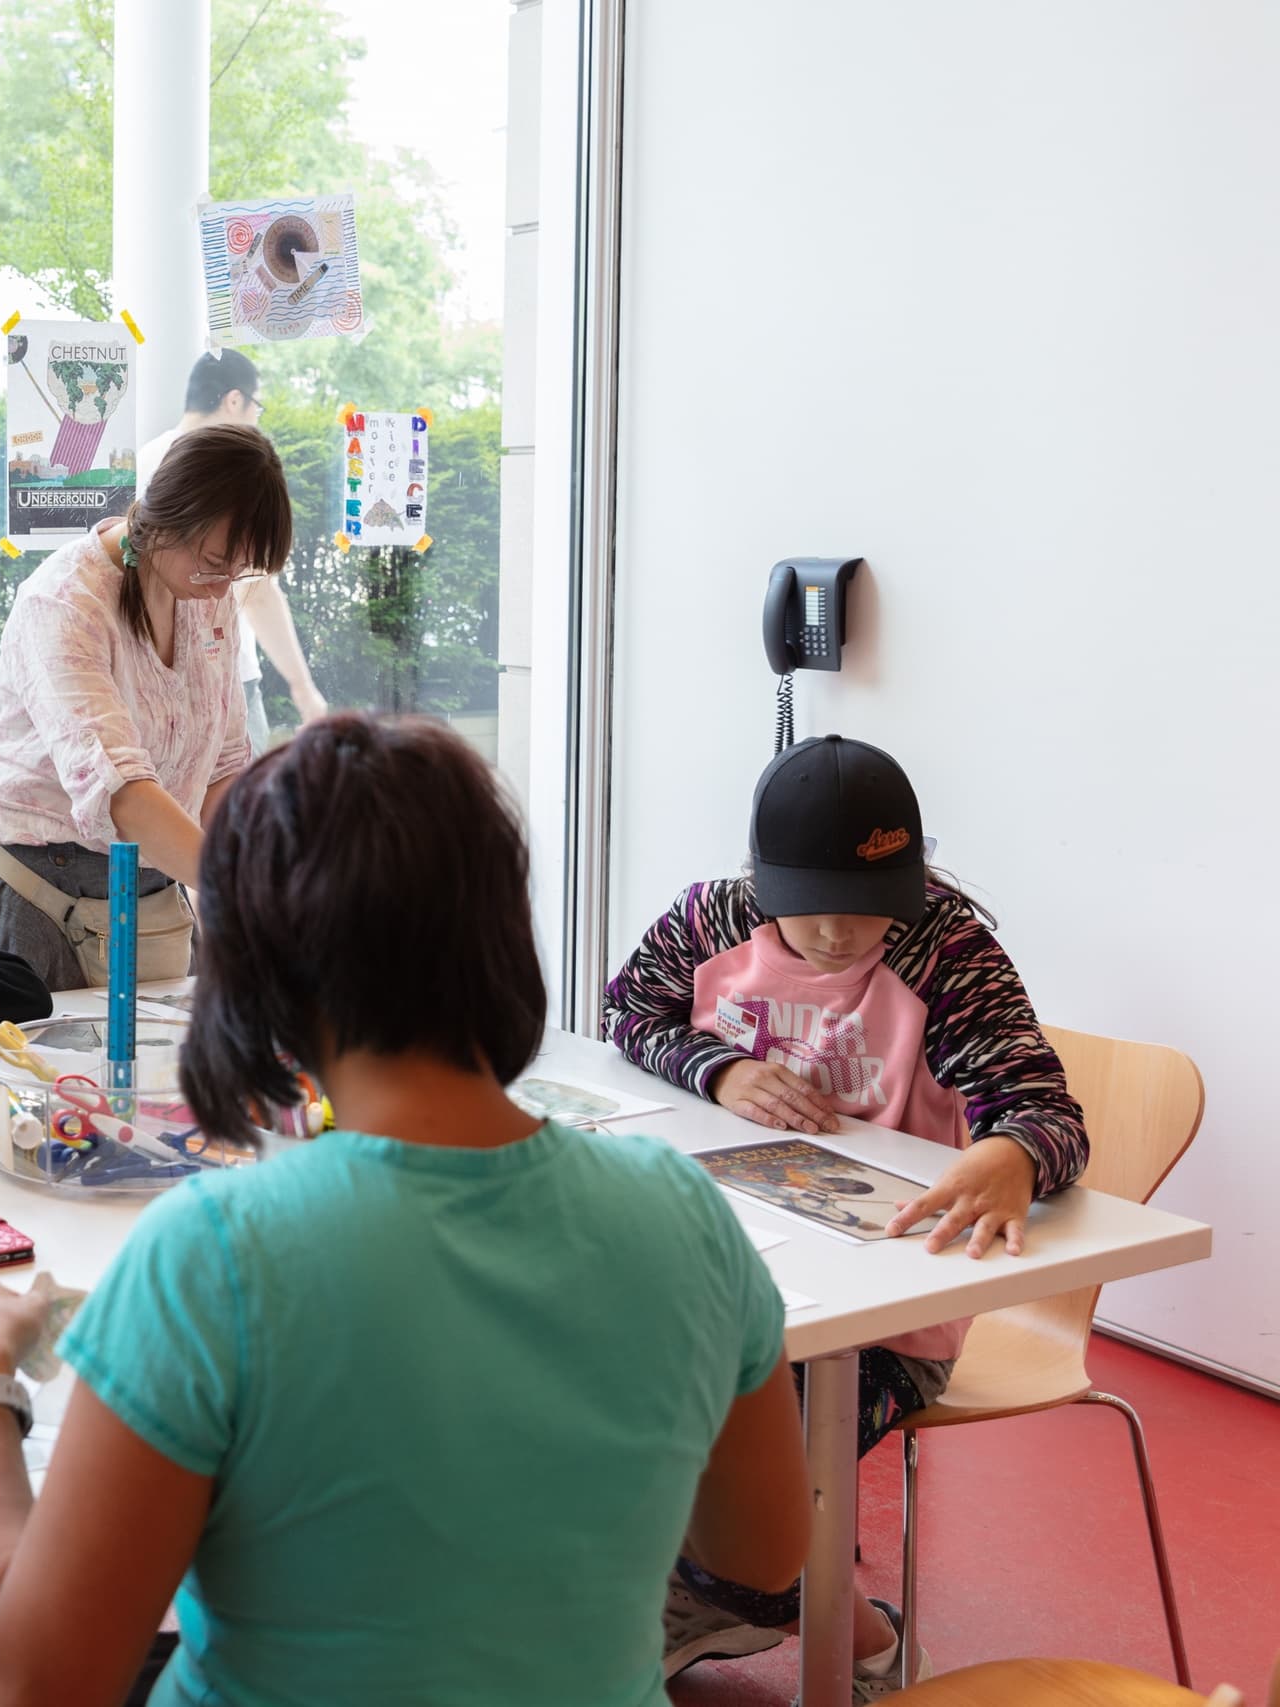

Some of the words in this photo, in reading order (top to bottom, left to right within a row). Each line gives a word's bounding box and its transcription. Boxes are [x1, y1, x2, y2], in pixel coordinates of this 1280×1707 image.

[51, 345, 126, 361] CHESTNUT
[18, 491, 107, 507] UNDERGROUND
[717, 1014, 747, 1036] Engage
[718, 1008, 741, 1026] Learn
